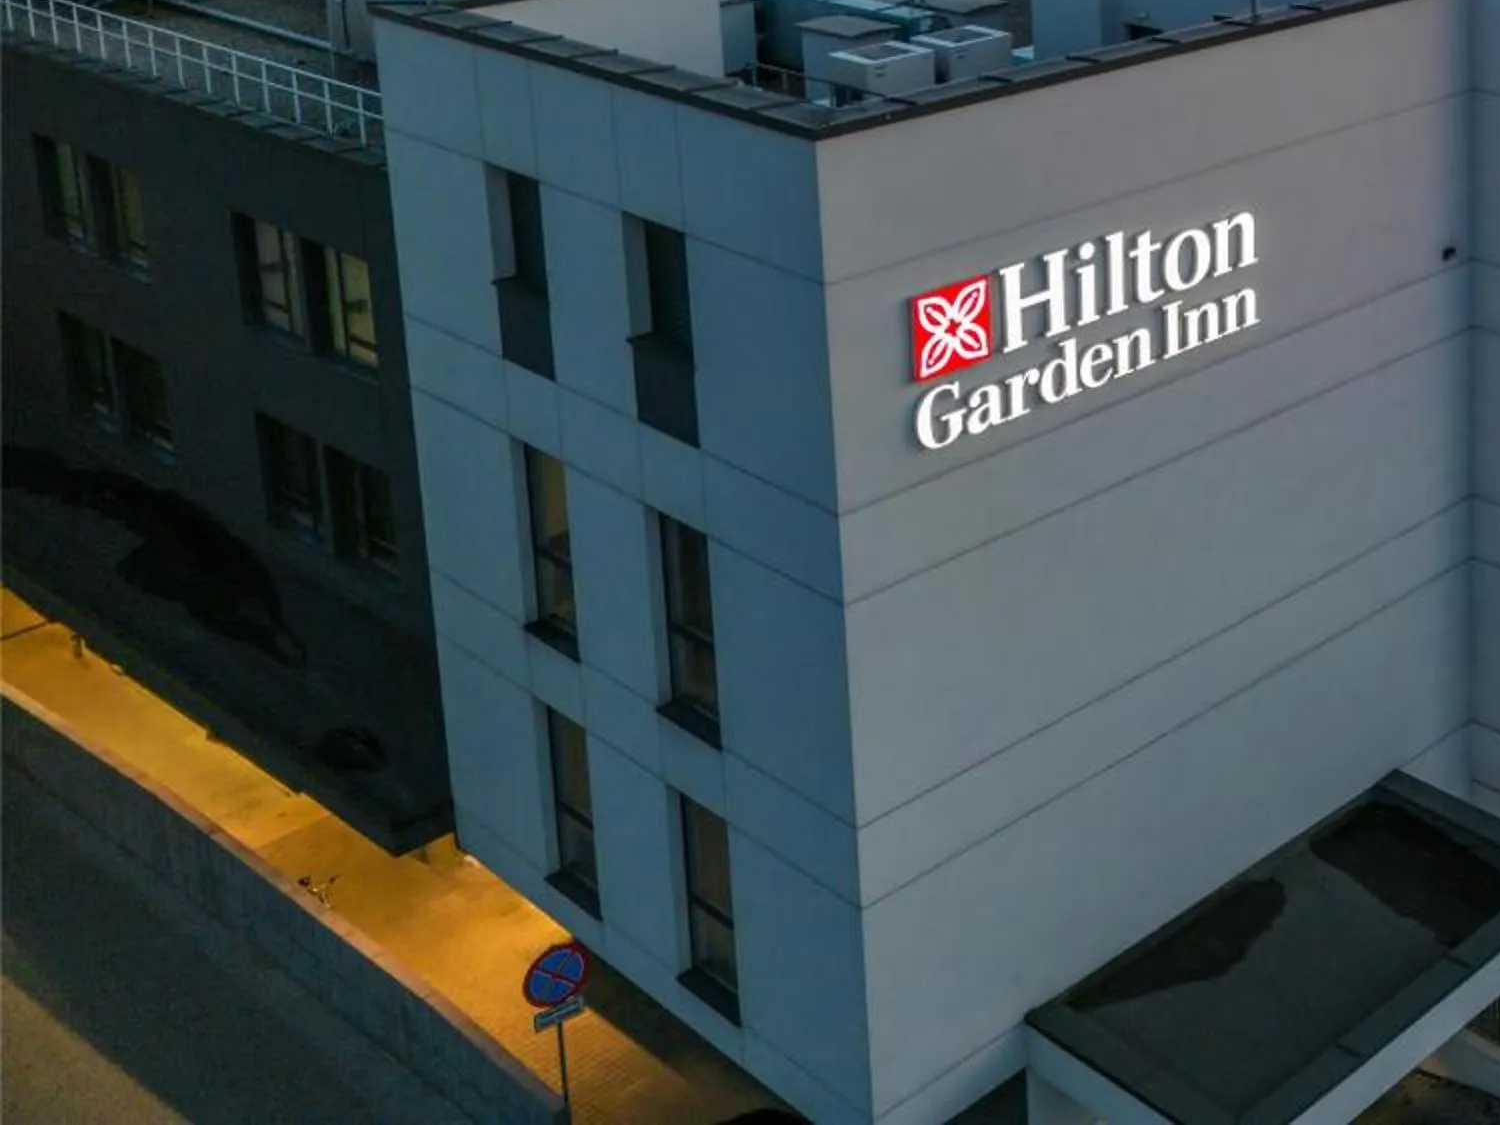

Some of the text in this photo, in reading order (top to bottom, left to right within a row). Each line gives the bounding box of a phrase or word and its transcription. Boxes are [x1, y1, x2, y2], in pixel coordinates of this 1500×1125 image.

[999, 211, 1259, 354] Hilton
[916, 287, 1261, 450] Garden Inn
